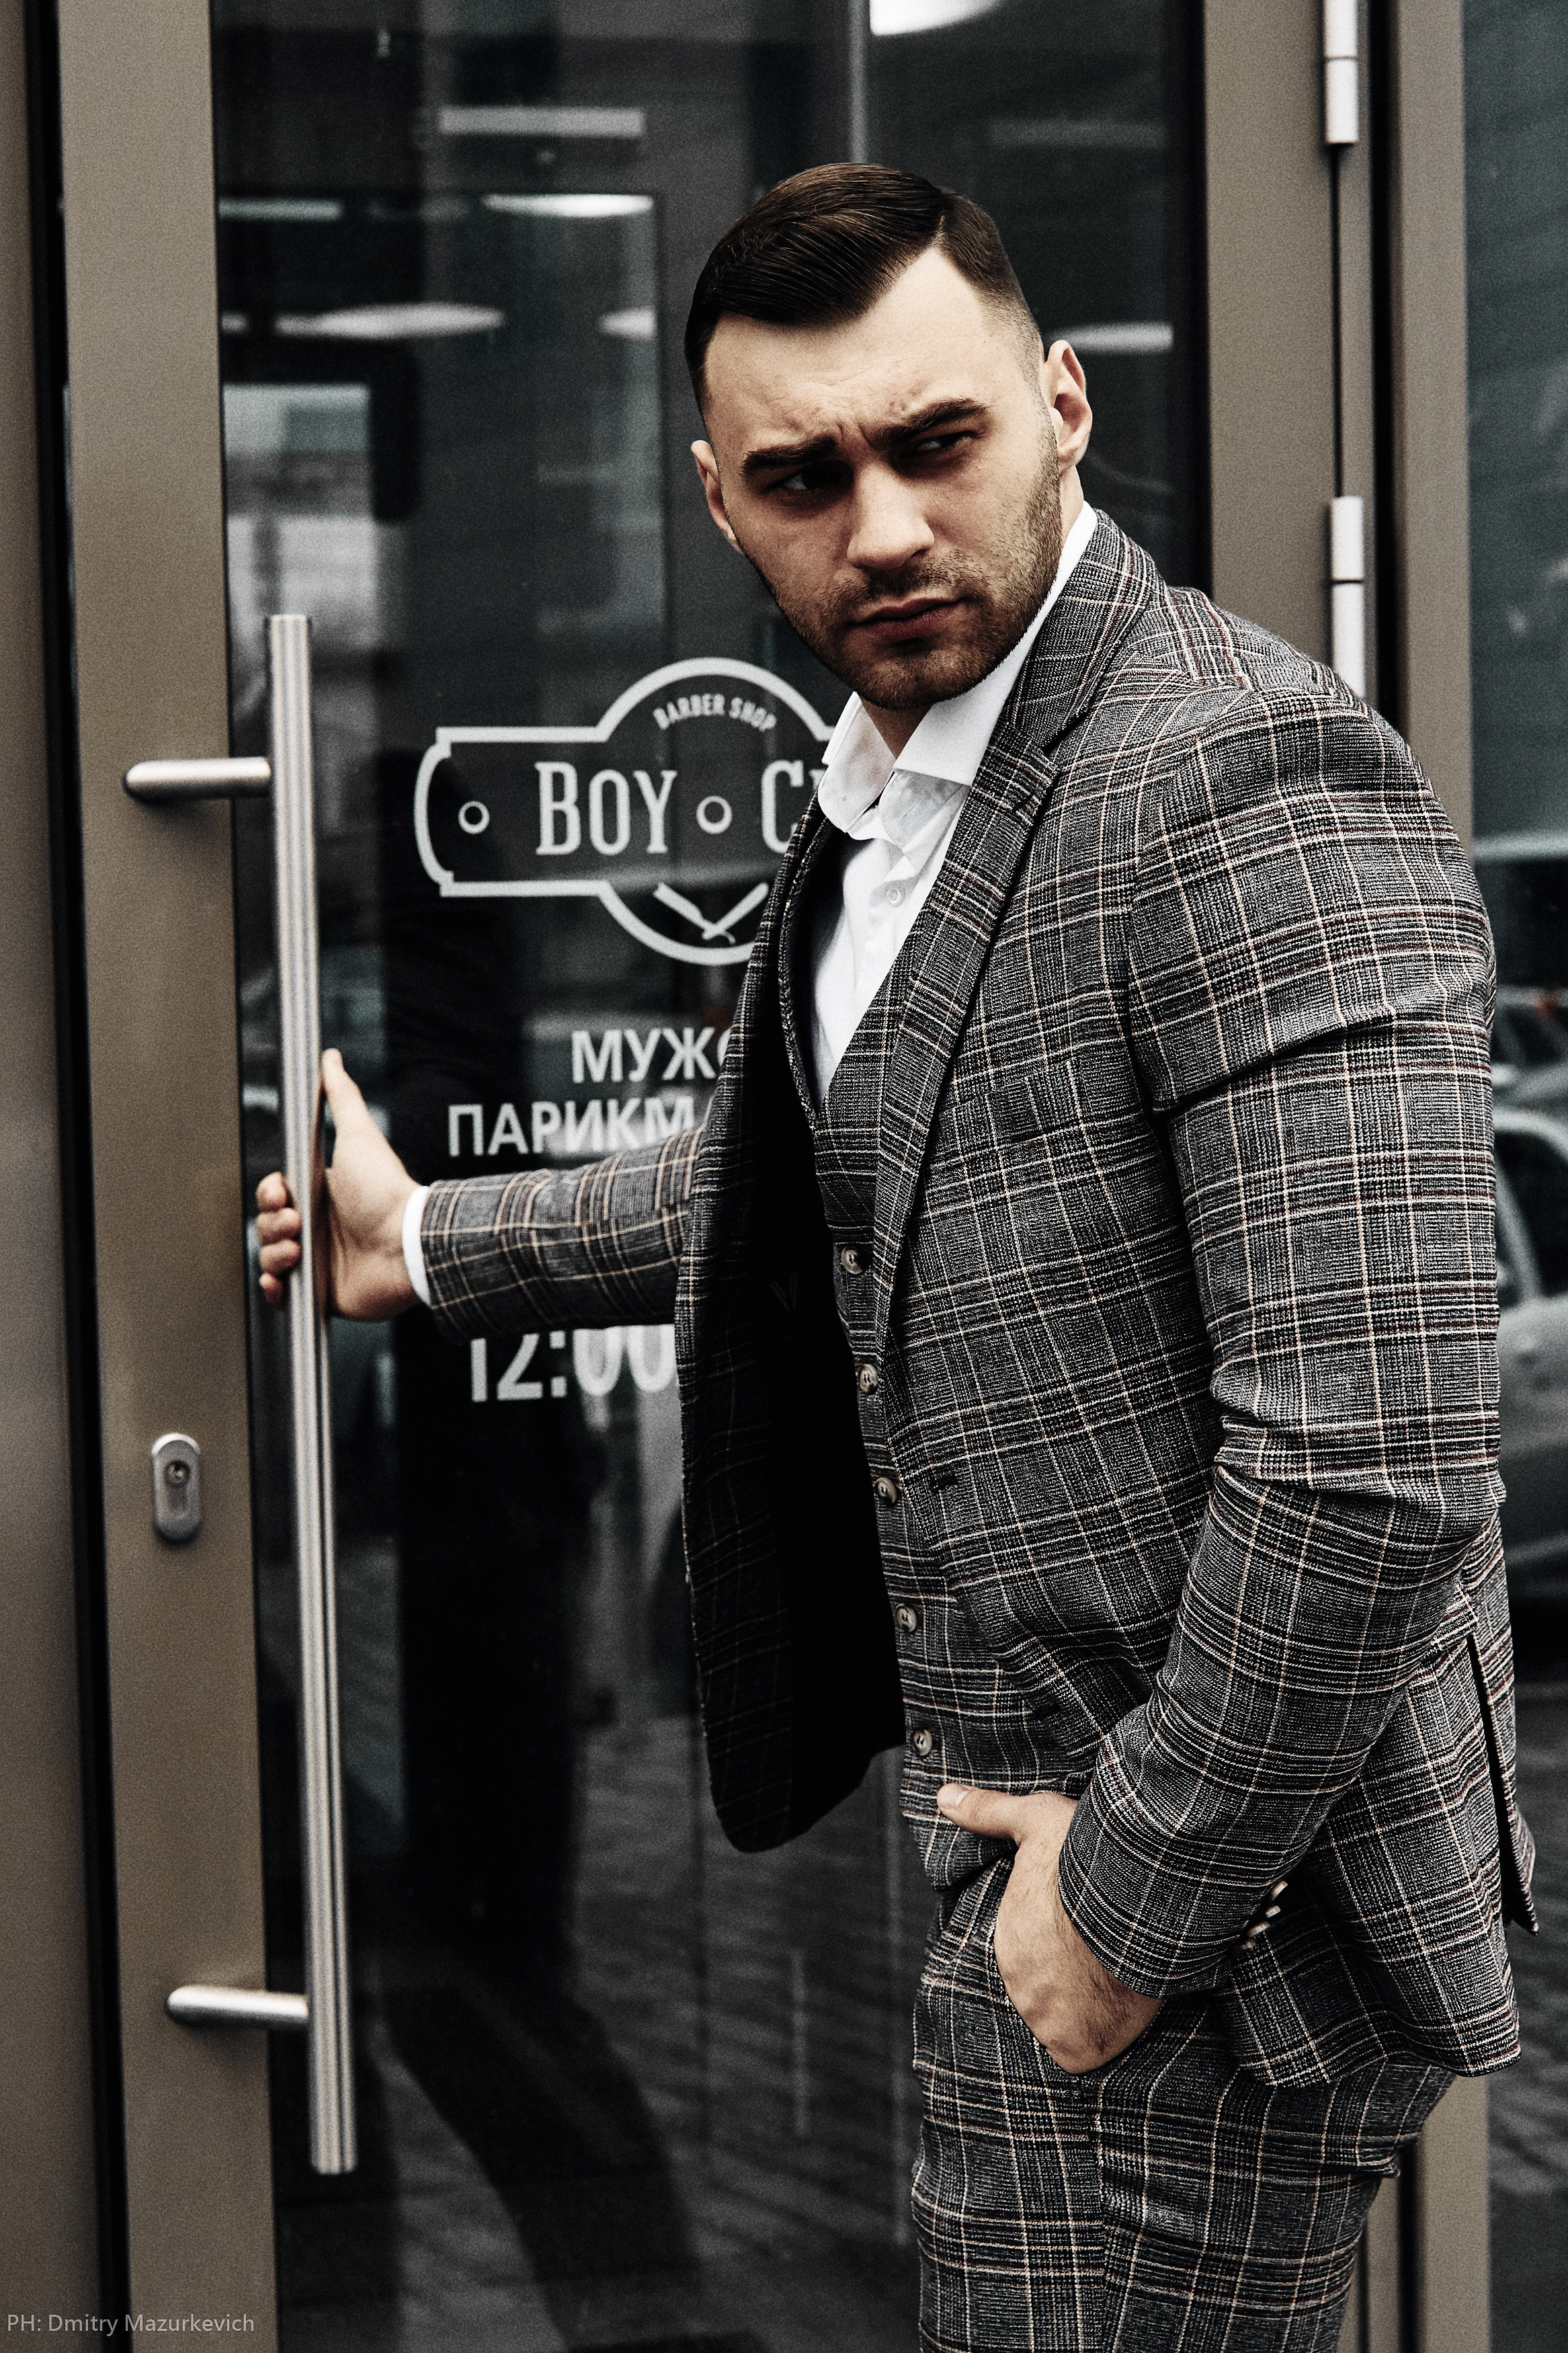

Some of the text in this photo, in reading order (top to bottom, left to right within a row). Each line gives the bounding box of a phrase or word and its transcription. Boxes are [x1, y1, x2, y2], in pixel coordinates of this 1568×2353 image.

[653, 693, 778, 732] BARBER SHOP
[535, 759, 826, 856] BOY C
